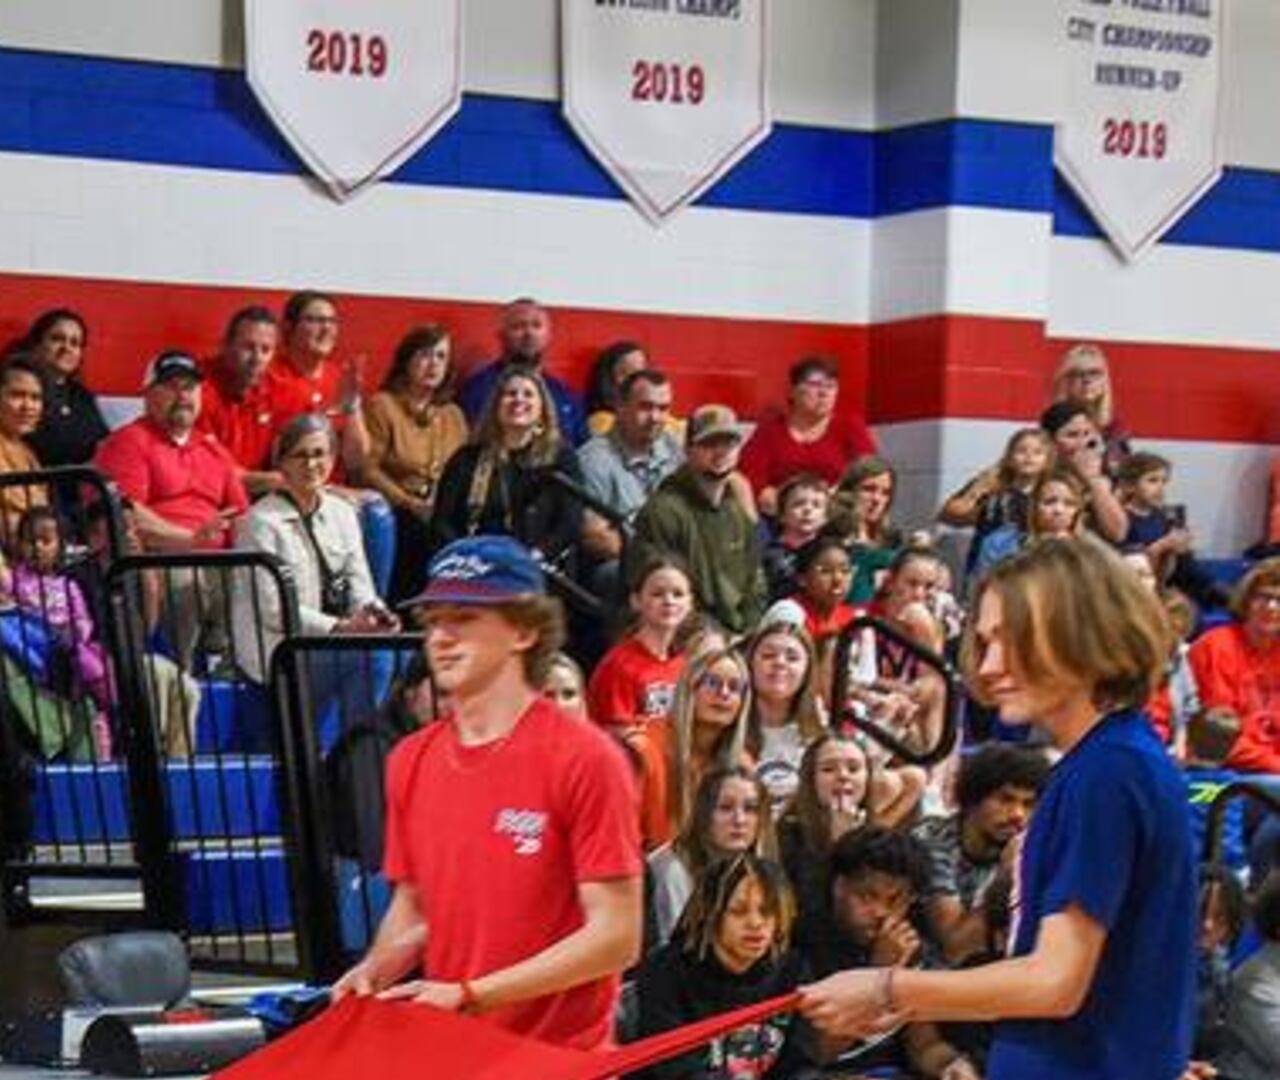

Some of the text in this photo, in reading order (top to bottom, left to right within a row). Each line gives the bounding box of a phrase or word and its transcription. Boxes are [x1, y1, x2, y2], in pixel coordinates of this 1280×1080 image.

[306, 29, 388, 77] 2019
[631, 60, 705, 105] 2019
[1103, 118, 1168, 159] 2019
